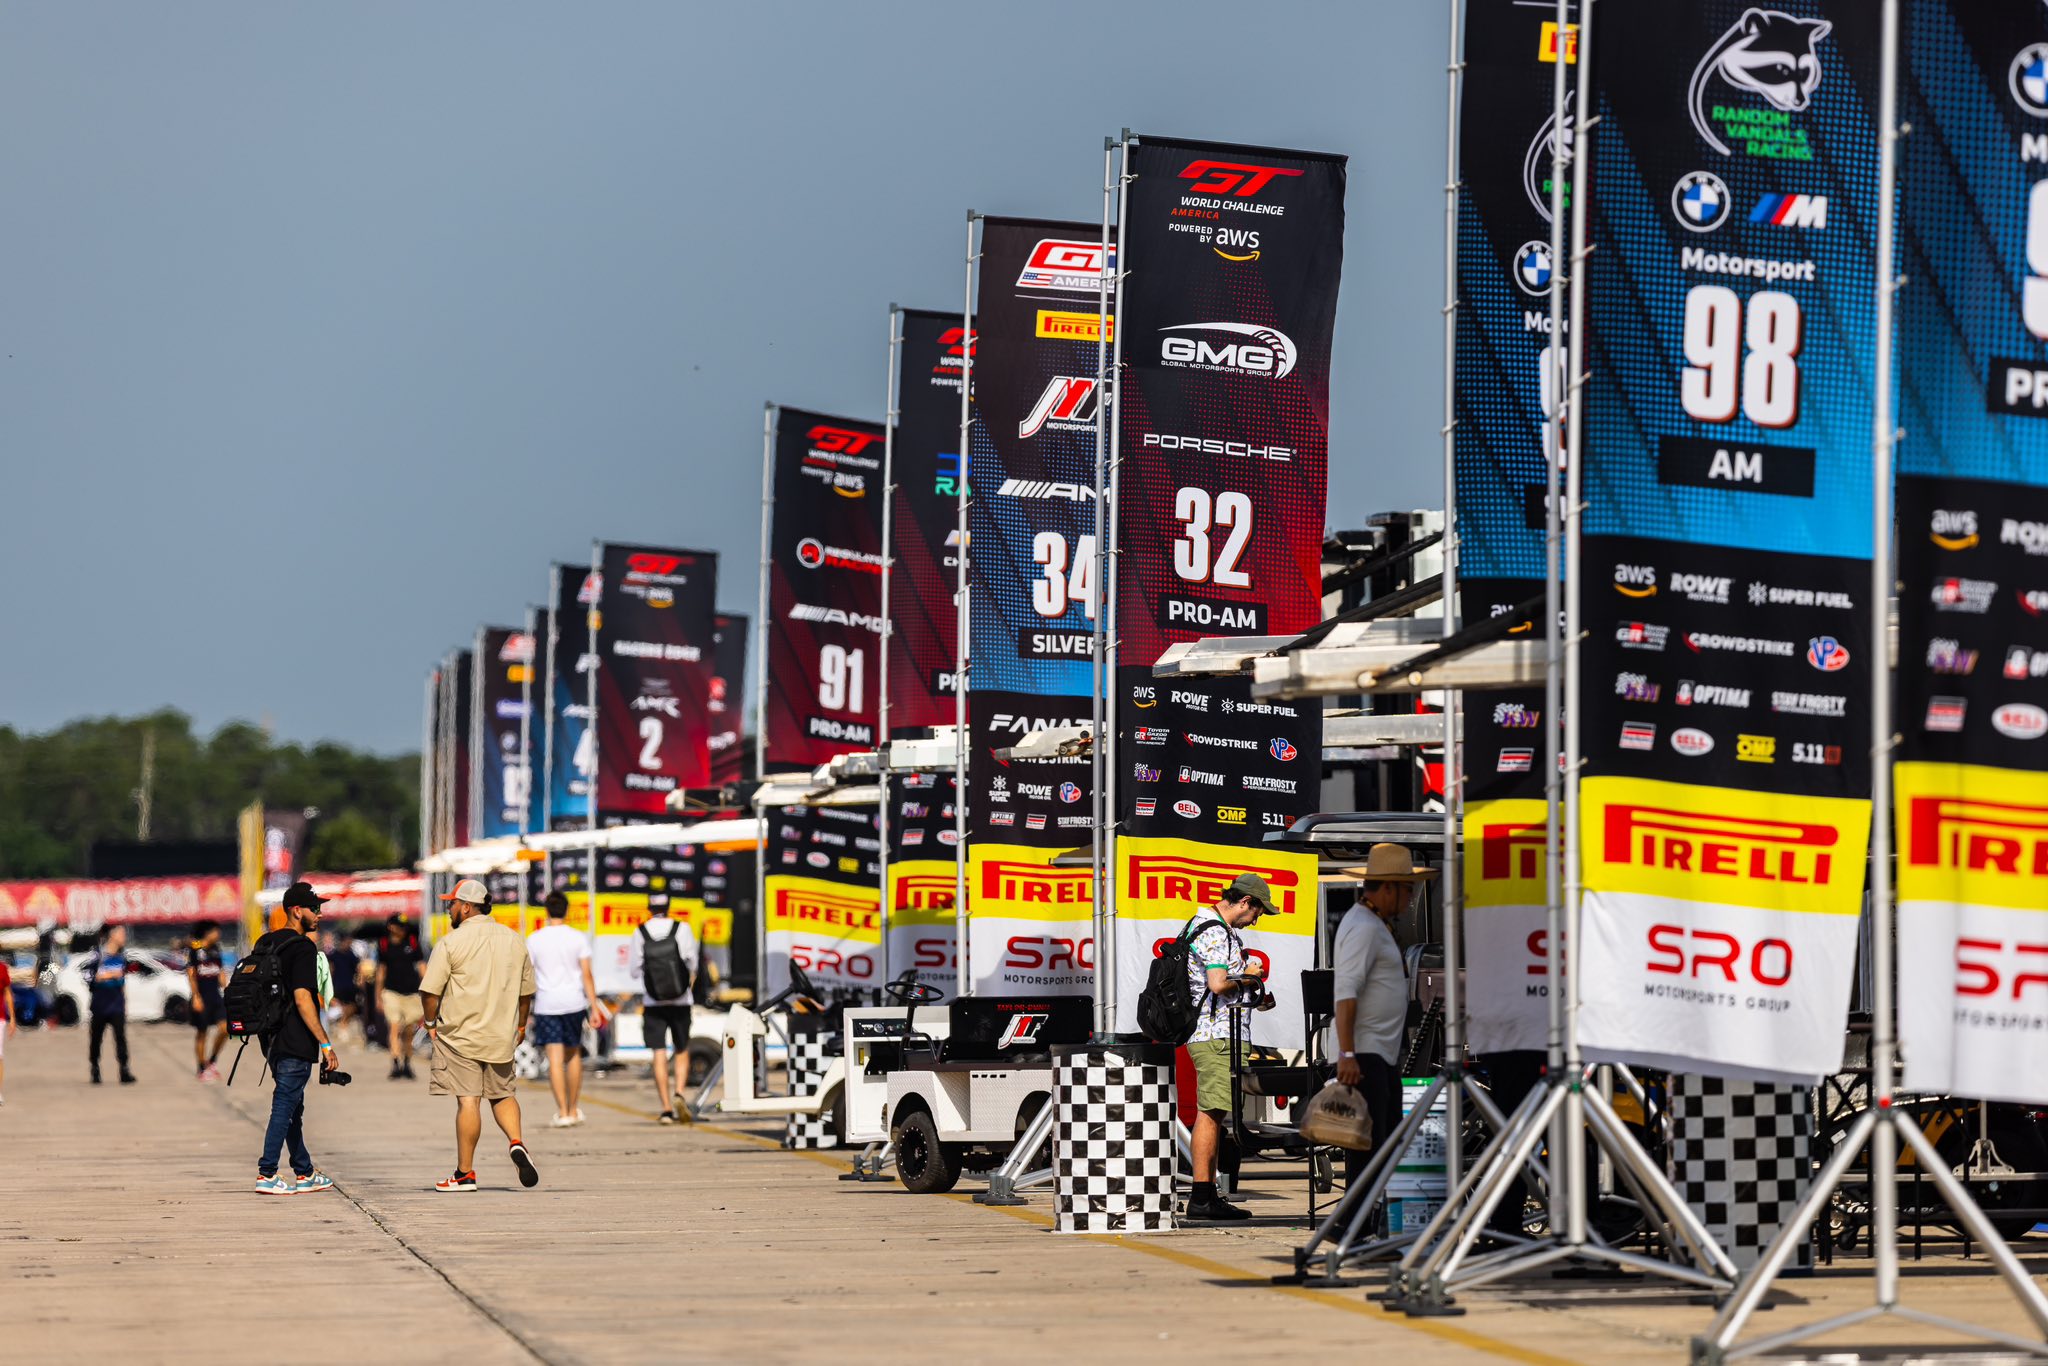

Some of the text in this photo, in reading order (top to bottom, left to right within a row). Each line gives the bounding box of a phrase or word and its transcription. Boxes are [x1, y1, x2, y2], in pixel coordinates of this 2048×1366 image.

[1711, 105, 1791, 127] RANDOM
[1725, 123, 1808, 144] VANDALS
[1746, 141, 1813, 161] RACING
[1176, 159, 1305, 197] GT
[1171, 207, 1220, 220] AMERICA
[1180, 196, 1285, 216] WORLD CHALLENGE
[1168, 223, 1213, 235] POWERED
[1199, 234, 1212, 244] BY
[1216, 227, 1260, 248] aws
[1681, 246, 1816, 283] Motorsport
[1161, 337, 1273, 370] GMG
[1680, 284, 1801, 428] 98
[1160, 360, 1272, 377] GLOBAL MOTORSPORTS GROUP
[806, 425, 887, 455] GT
[1143, 433, 1291, 461] PORSCHE
[1707, 448, 1763, 483] AM
[1174, 486, 1253, 589] 32
[1614, 563, 1656, 585] aws
[1669, 572, 1731, 598] ROWE
[1768, 587, 1814, 606] SUPER
[1168, 600, 1257, 630] PRO-AM
[1032, 634, 1095, 656] SILVE
[1688, 631, 1794, 656] CROWDSTRIKE
[819, 643, 864, 715] 91
[1133, 685, 1156, 699] aws
[1171, 690, 1210, 707] ROWE
[1693, 684, 1751, 709] OPTIMA
[1236, 702, 1272, 714] SUPER
[809, 717, 871, 745] PRO-AM
[1187, 733, 1258, 750] CROWDSTRIKE
[638, 716, 664, 770] 2
[1270, 737, 1289, 760] VP
[1017, 782, 1053, 795] ROWE
[1190, 771, 1224, 786] OPTIMA
[988, 790, 1011, 798] SUPER
[1177, 803, 1198, 814] BELL
[1217, 808, 1247, 822] OMP
[1262, 812, 1285, 827] 5.11
[1603, 803, 1839, 885] PIRELLI
[981, 860, 1094, 903] PIREL
[1128, 854, 1299, 915] PIREI
[776, 888, 881, 931] PIRELL
[1646, 924, 1793, 988] SRO
[1004, 974, 1073, 985] MOTORSPORTS
[1644, 983, 1791, 1013] MOTORSPORTS GROUP
